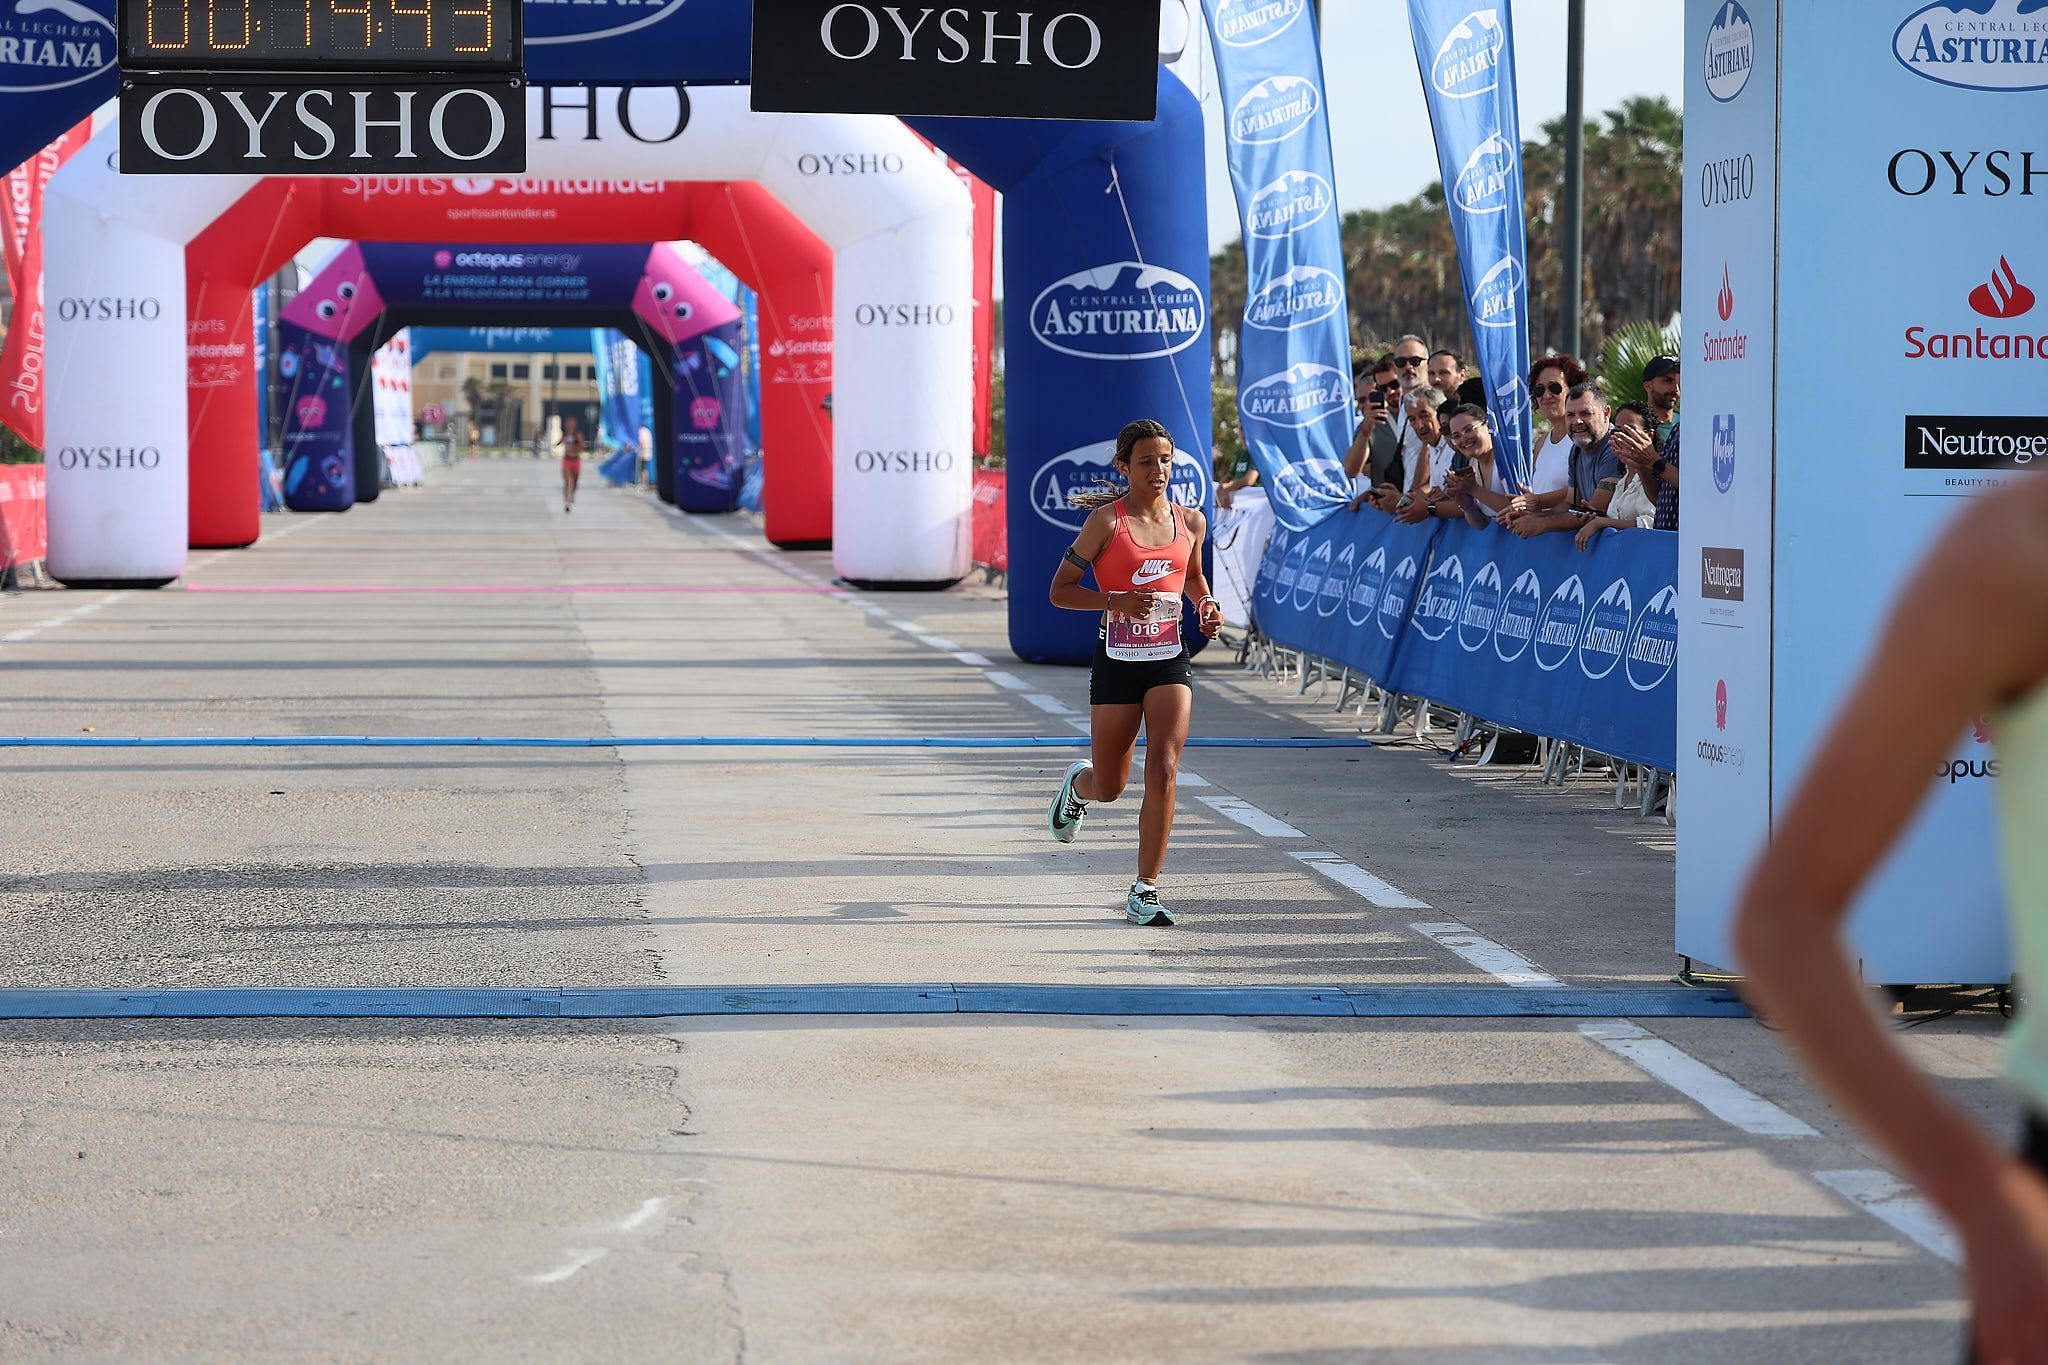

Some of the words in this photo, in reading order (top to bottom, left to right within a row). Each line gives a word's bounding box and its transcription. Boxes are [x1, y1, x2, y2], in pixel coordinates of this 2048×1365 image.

[820, 3, 1102, 69] OYSHO
[1944, 21, 2016, 32] CENTRAL
[1706, 42, 1750, 80] ASTURIANA
[140, 88, 506, 161] OYSHO
[797, 153, 904, 176] OYSHO
[1701, 153, 1754, 208] OYSHO
[58, 297, 160, 321] OYSHO
[854, 303, 954, 327] OYSHO
[1070, 295, 1136, 307] CENTRAL
[1041, 299, 1198, 336] ASTURIANA
[1703, 329, 1747, 362] Santander
[58, 446, 160, 471] OYSHO
[1917, 426, 2048, 464] Neutroge
[854, 450, 954, 473] OYSHO
[1945, 478, 1983, 487] BEAUTY
[1139, 559, 1173, 574] NIKE
[1704, 558, 1742, 595] Neutrogena
[1132, 623, 1160, 635] 016
[1581, 612, 1624, 655] ASTURIANA
[1628, 620, 1675, 666] ASTURIANA
